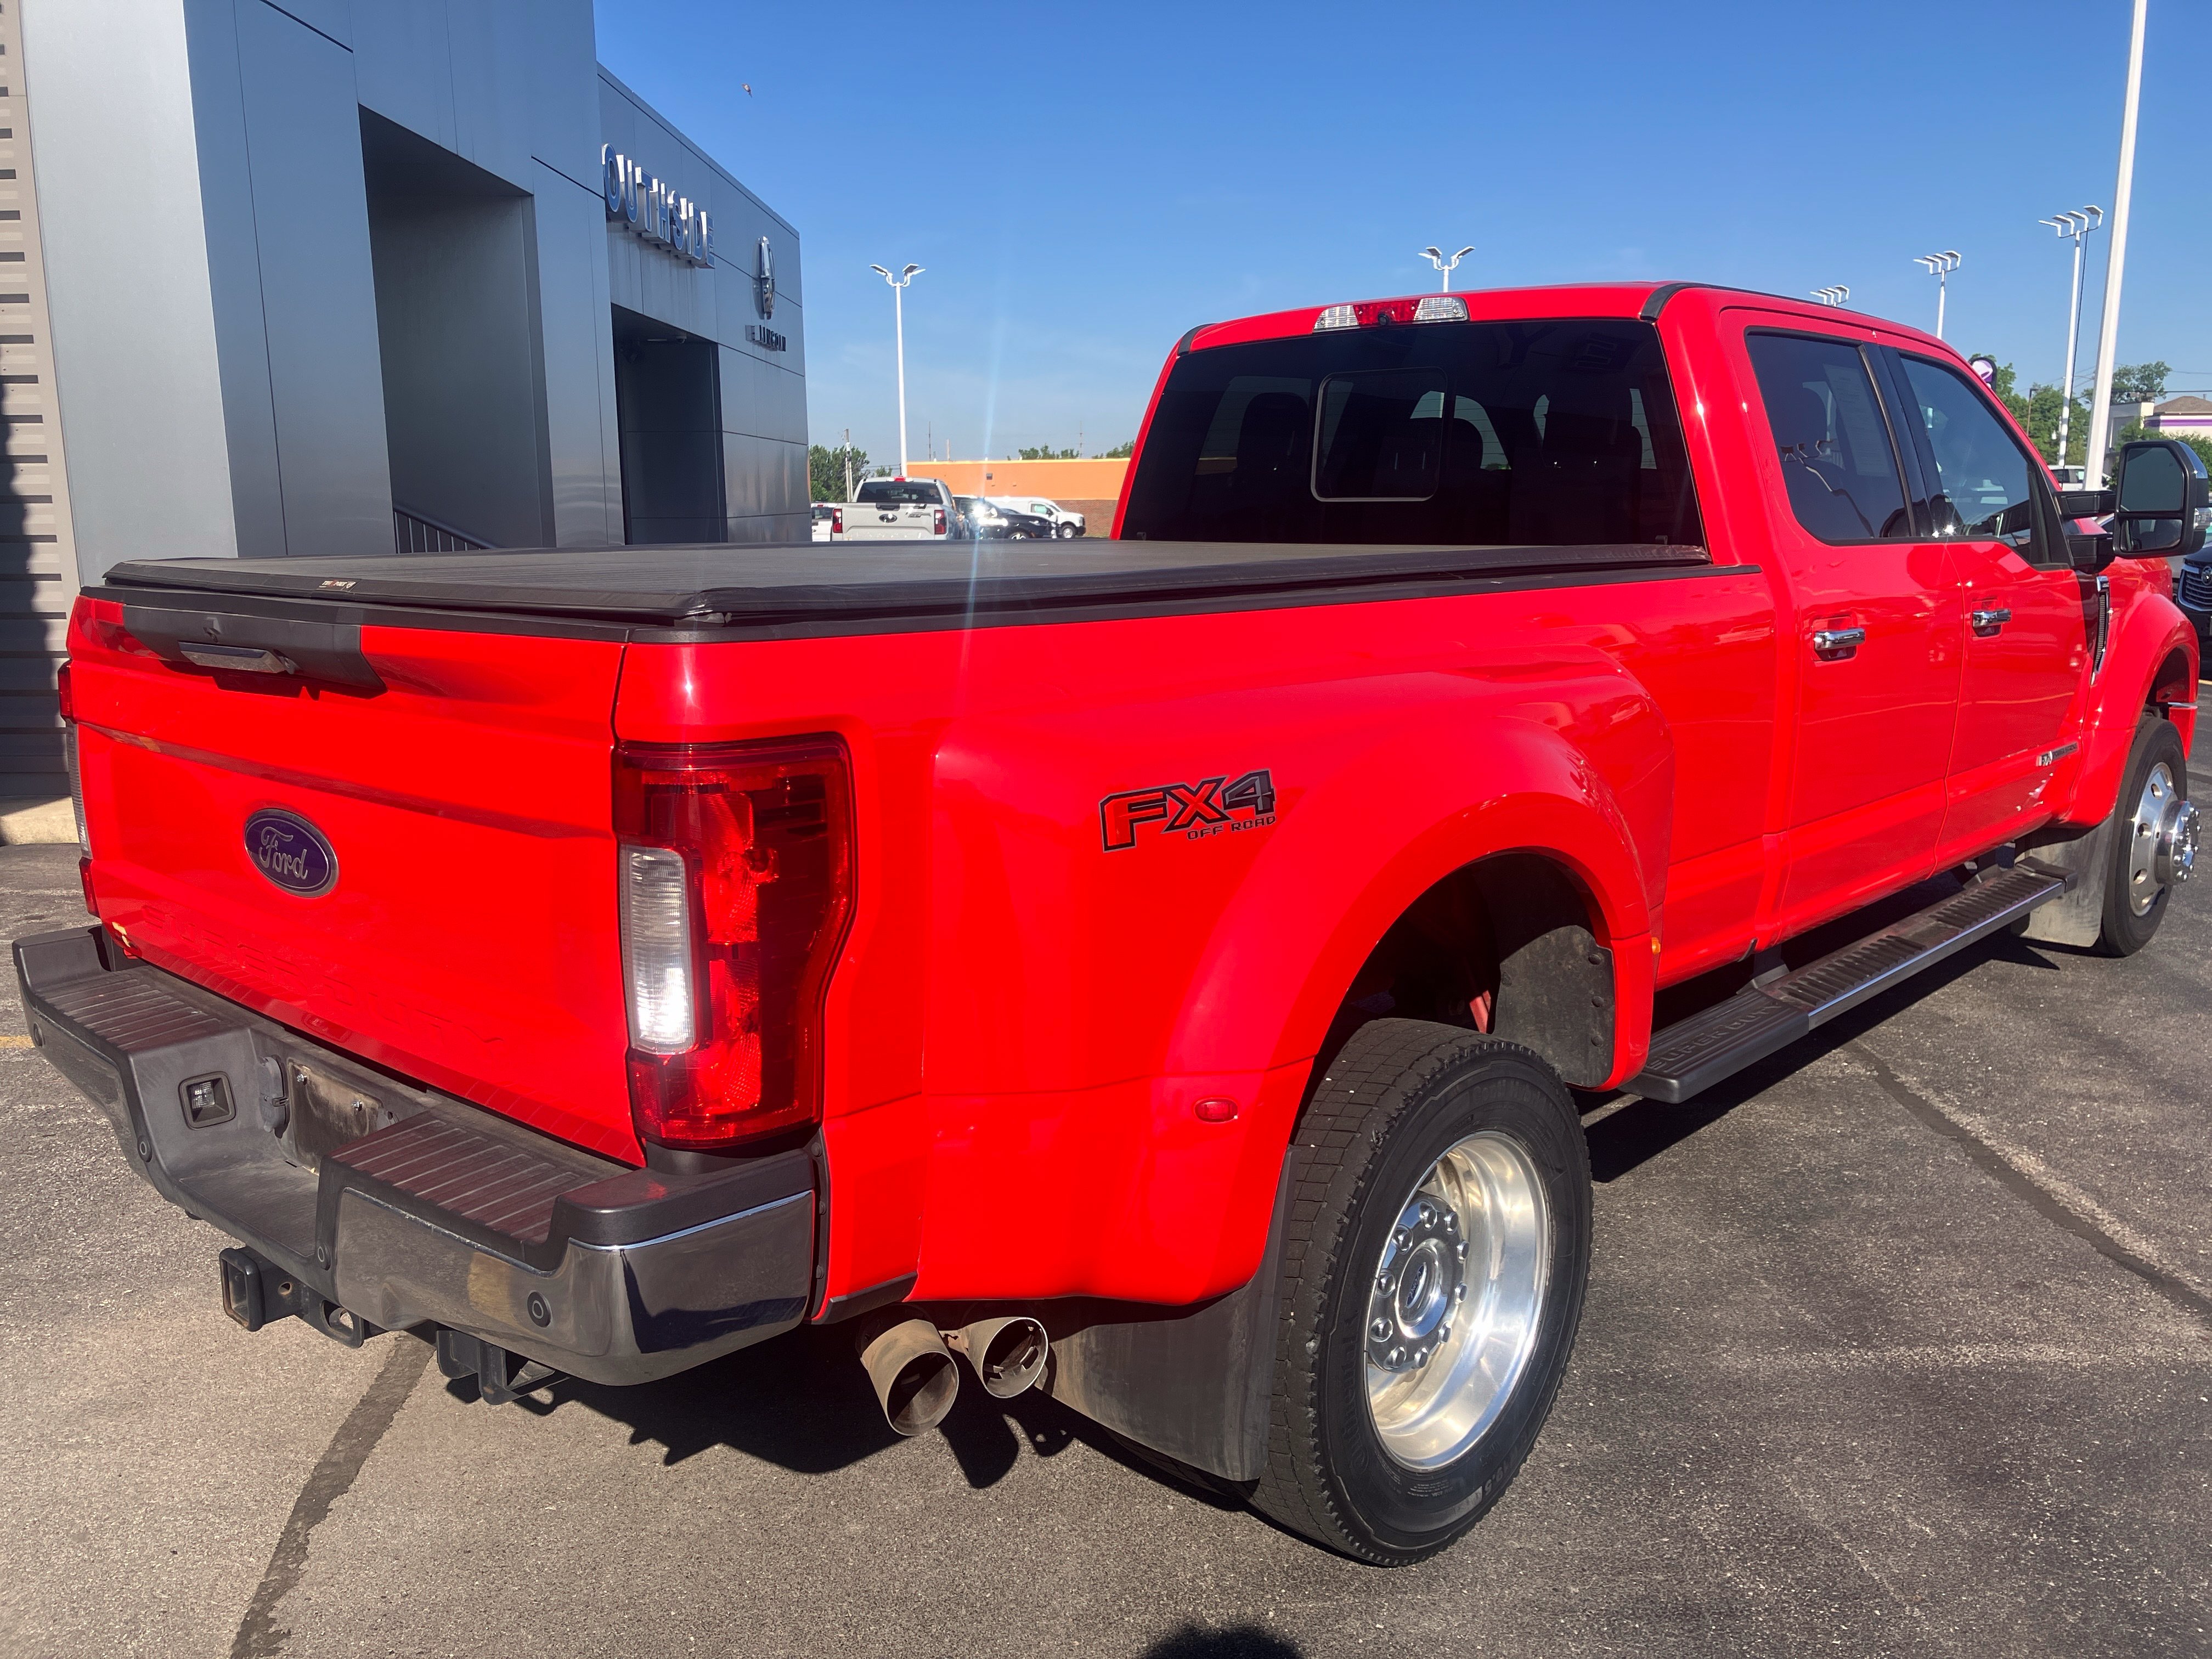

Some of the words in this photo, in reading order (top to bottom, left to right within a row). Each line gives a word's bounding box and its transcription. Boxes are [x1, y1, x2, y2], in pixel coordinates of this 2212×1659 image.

[756, 325, 786, 352] LINCOLN
[1099, 769, 1277, 853] FX4
[1187, 825, 1224, 840] OFF
[1231, 815, 1277, 832] ROAD
[258, 826, 308, 880] Ford
[1646, 1025, 1730, 1070] SUPER
[1727, 1002, 1782, 1030] DUTY
